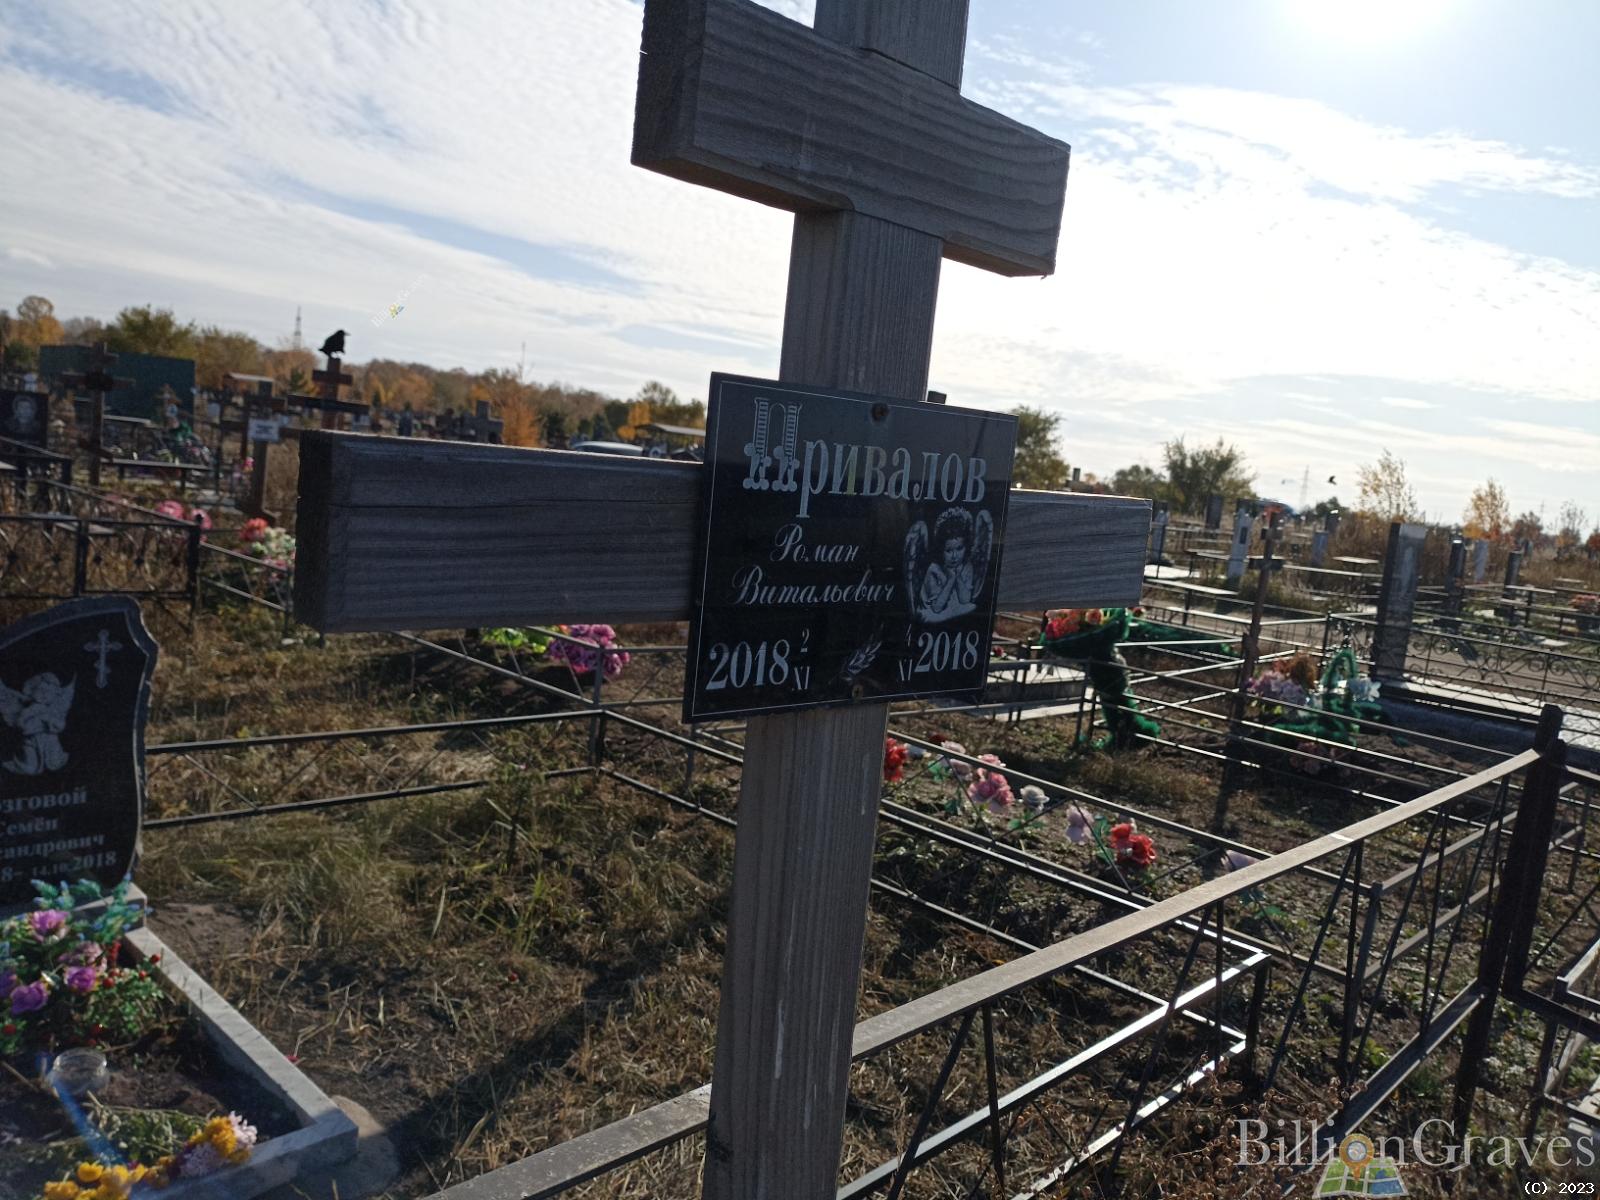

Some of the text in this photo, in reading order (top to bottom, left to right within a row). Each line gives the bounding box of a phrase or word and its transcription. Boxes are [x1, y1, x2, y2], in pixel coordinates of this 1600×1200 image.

[743, 397, 987, 519] Привалов
[770, 523, 862, 562] Роман
[732, 565, 895, 605] Витальевич
[706, 639, 790, 690] 2018
[800, 627, 810, 653] 2
[914, 630, 980, 673] 2018
[0, 785, 87, 813] зговой
[0, 835, 104, 859] андрович
